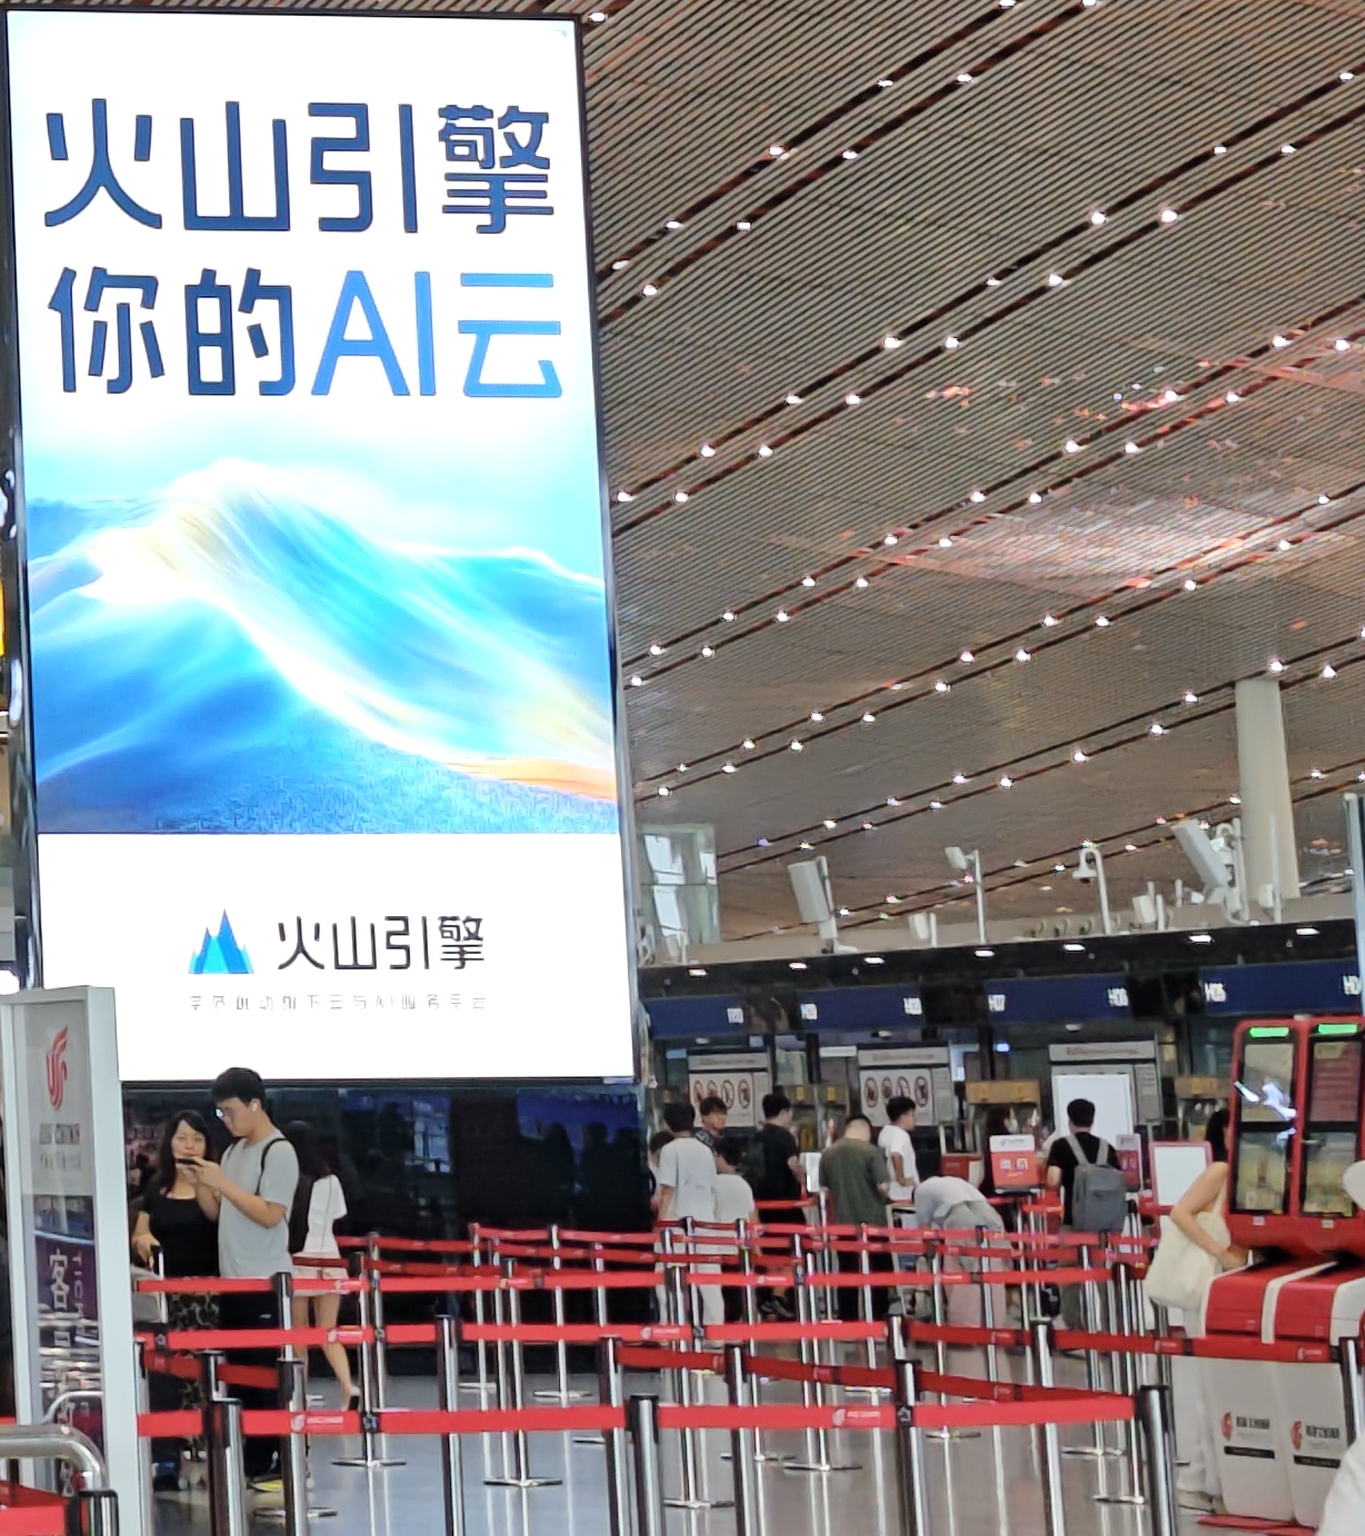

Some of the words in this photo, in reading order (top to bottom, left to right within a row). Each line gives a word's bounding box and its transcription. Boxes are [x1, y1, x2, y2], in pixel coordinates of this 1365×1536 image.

[44, 98, 555, 234] 火山引擎
[47, 266, 563, 399] 你的AI云
[277, 915, 485, 970] 火山引擎
